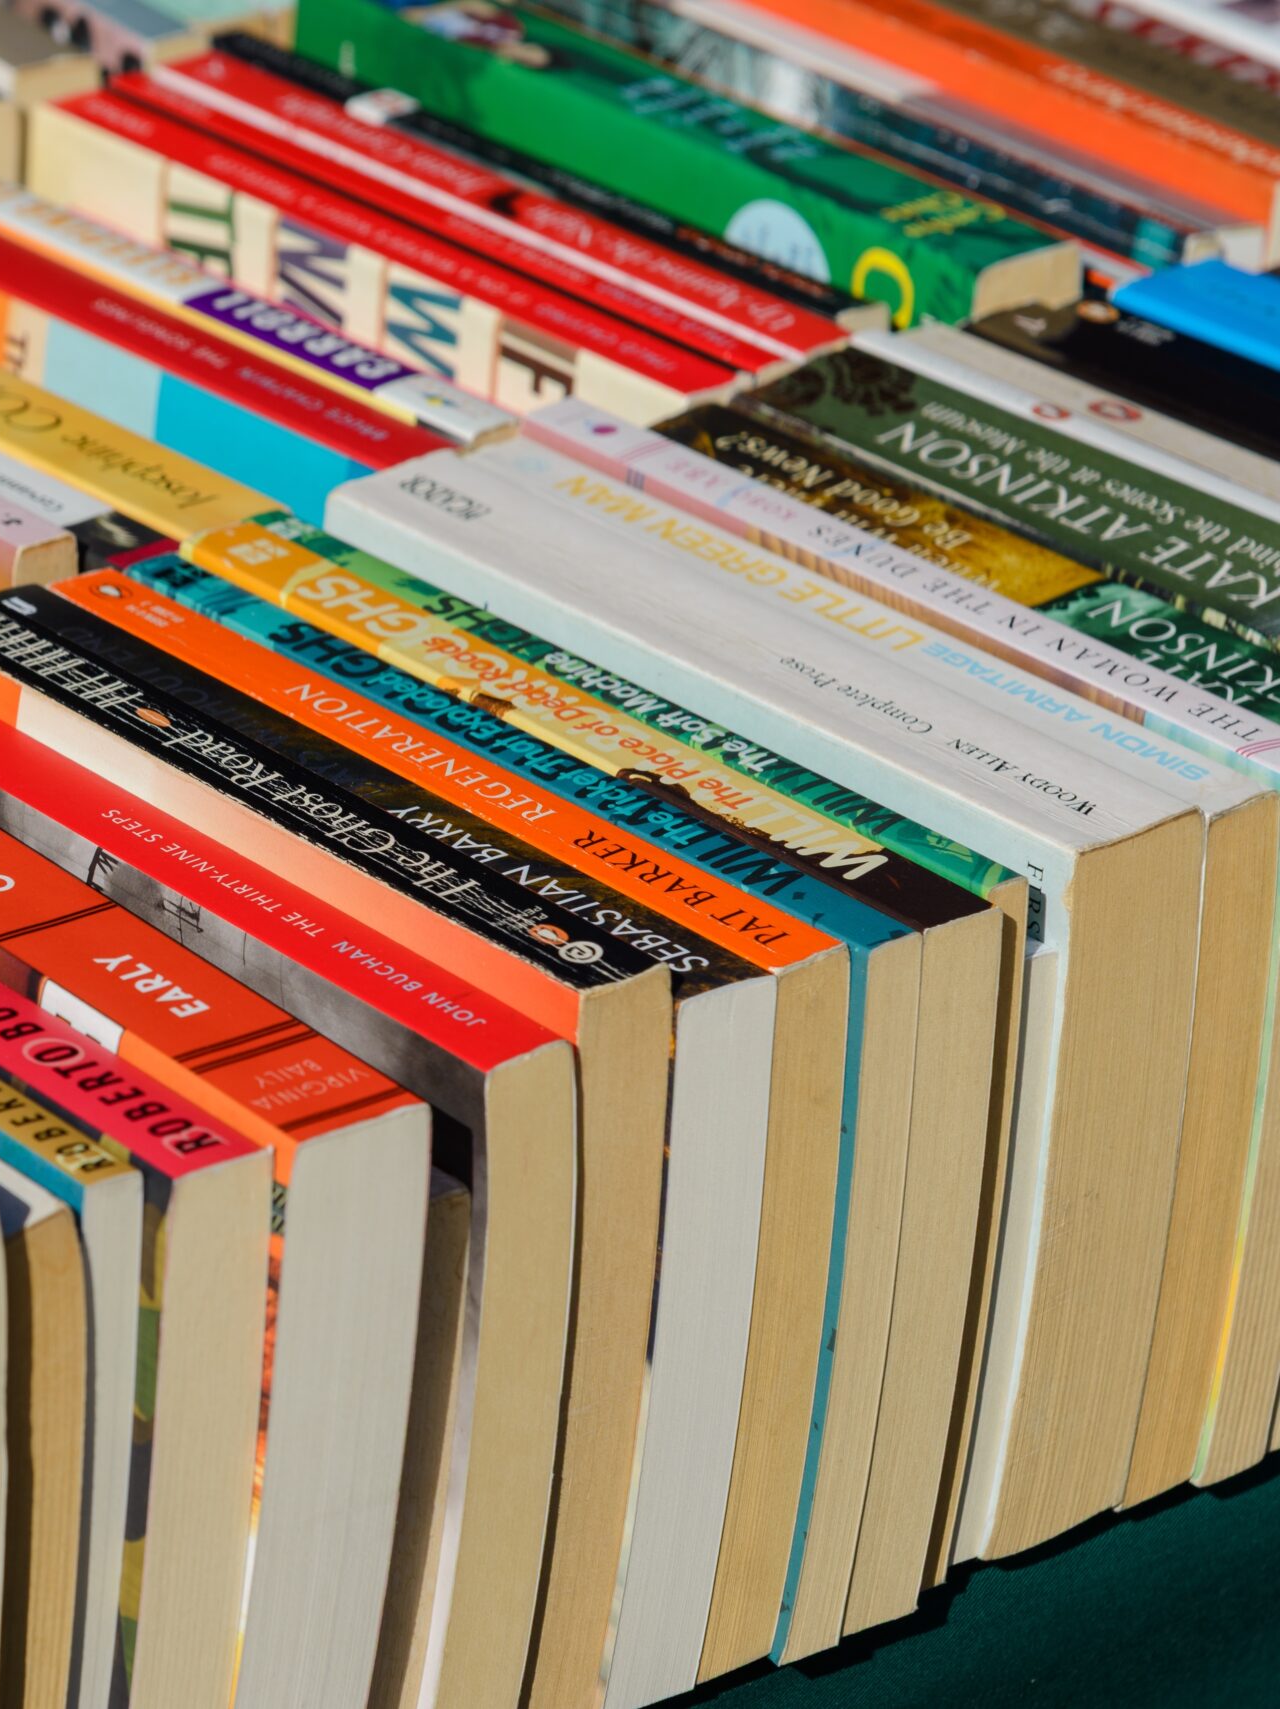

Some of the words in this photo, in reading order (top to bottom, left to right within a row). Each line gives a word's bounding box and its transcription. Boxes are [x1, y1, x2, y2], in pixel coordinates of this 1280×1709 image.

[210, 284, 402, 378] CARROLL
[553, 473, 653, 525] MAN
[821, 478, 921, 529] Good
[874, 419, 1152, 543] ATKINSON
[646, 514, 790, 588] GREEN
[1138, 534, 1280, 611] KATE
[776, 580, 926, 652] LITTLE
[921, 581, 994, 616] THE
[997, 616, 1044, 638] IN
[1086, 600, 1280, 703] KINSON
[543, 651, 668, 716] Machine
[779, 655, 837, 690] Prose
[920, 640, 1096, 725] ARMITAGE
[1045, 637, 1180, 704] WOMAN
[366, 670, 499, 743] Exploded
[572, 718, 621, 739] of
[656, 712, 723, 745] Soft
[835, 675, 935, 736] Complete
[1187, 701, 1264, 743] THE
[160, 727, 286, 792] Road
[282, 681, 557, 824] REGENERATION
[490, 731, 564, 782] That
[618, 735, 701, 782] Place
[723, 739, 780, 774] The
[950, 736, 1021, 775] ALLEN
[1088, 720, 1212, 783] SIMON
[554, 766, 638, 819] Ticket
[697, 776, 755, 811] The
[1014, 769, 1100, 818] WOODY
[100, 807, 164, 845] STEPS
[386, 804, 515, 868] BARRY
[646, 808, 703, 848] The
[161, 843, 287, 914] THIRTY-NINE
[397, 849, 481, 904] The
[572, 828, 721, 906] BARKER
[280, 911, 326, 939] THE
[515, 860, 711, 975] SEBASTIAN
[707, 908, 790, 945] PAT
[1026, 860, 1045, 944] FIRS
[91, 952, 212, 1019] EARLY
[331, 939, 423, 996] BUCHAN
[419, 991, 488, 1029] JOHN
[34, 1044, 220, 1158] ROBERTO
[250, 1067, 372, 1112] VIRGINIA
[254, 1057, 326, 1090] BAILY
